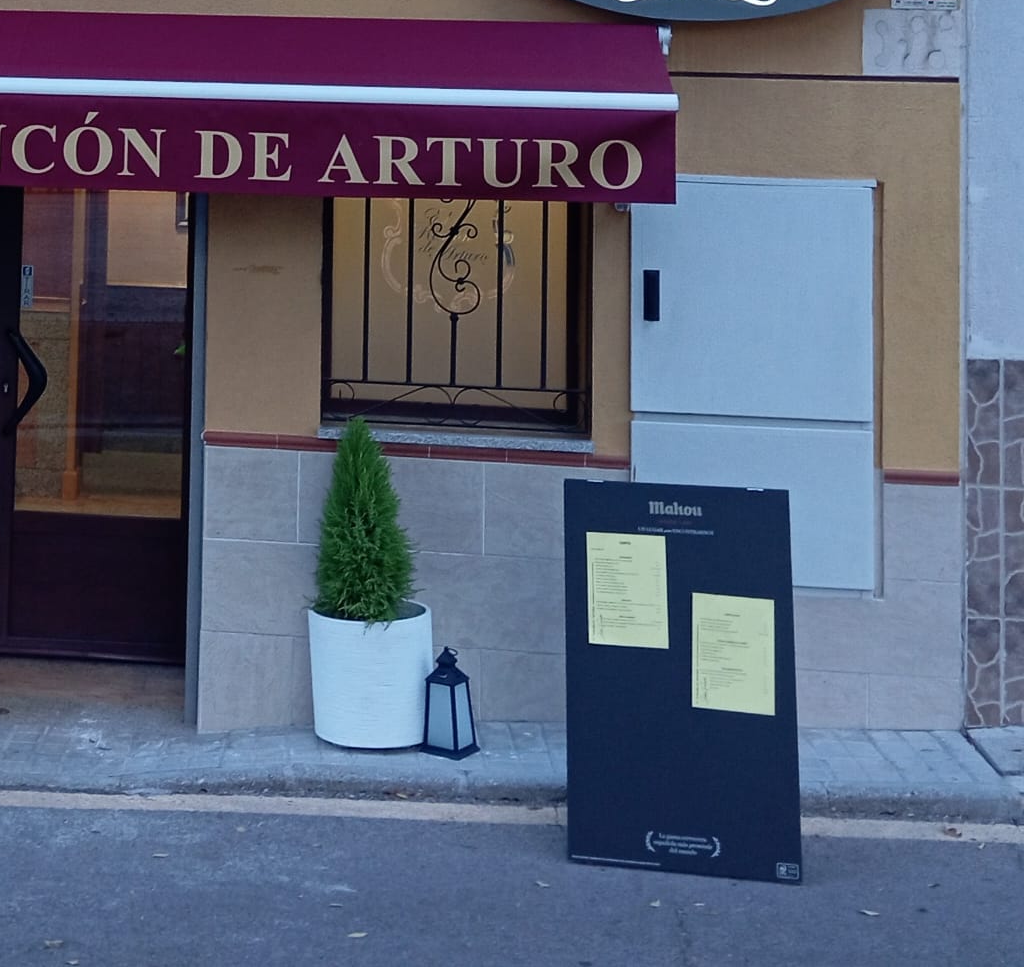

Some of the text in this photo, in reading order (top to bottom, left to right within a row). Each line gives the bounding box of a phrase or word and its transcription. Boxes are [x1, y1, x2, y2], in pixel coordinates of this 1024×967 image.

[193, 129, 293, 182] DE
[317, 133, 644, 190] ARTURO
[648, 500, 703, 517] Mahou
